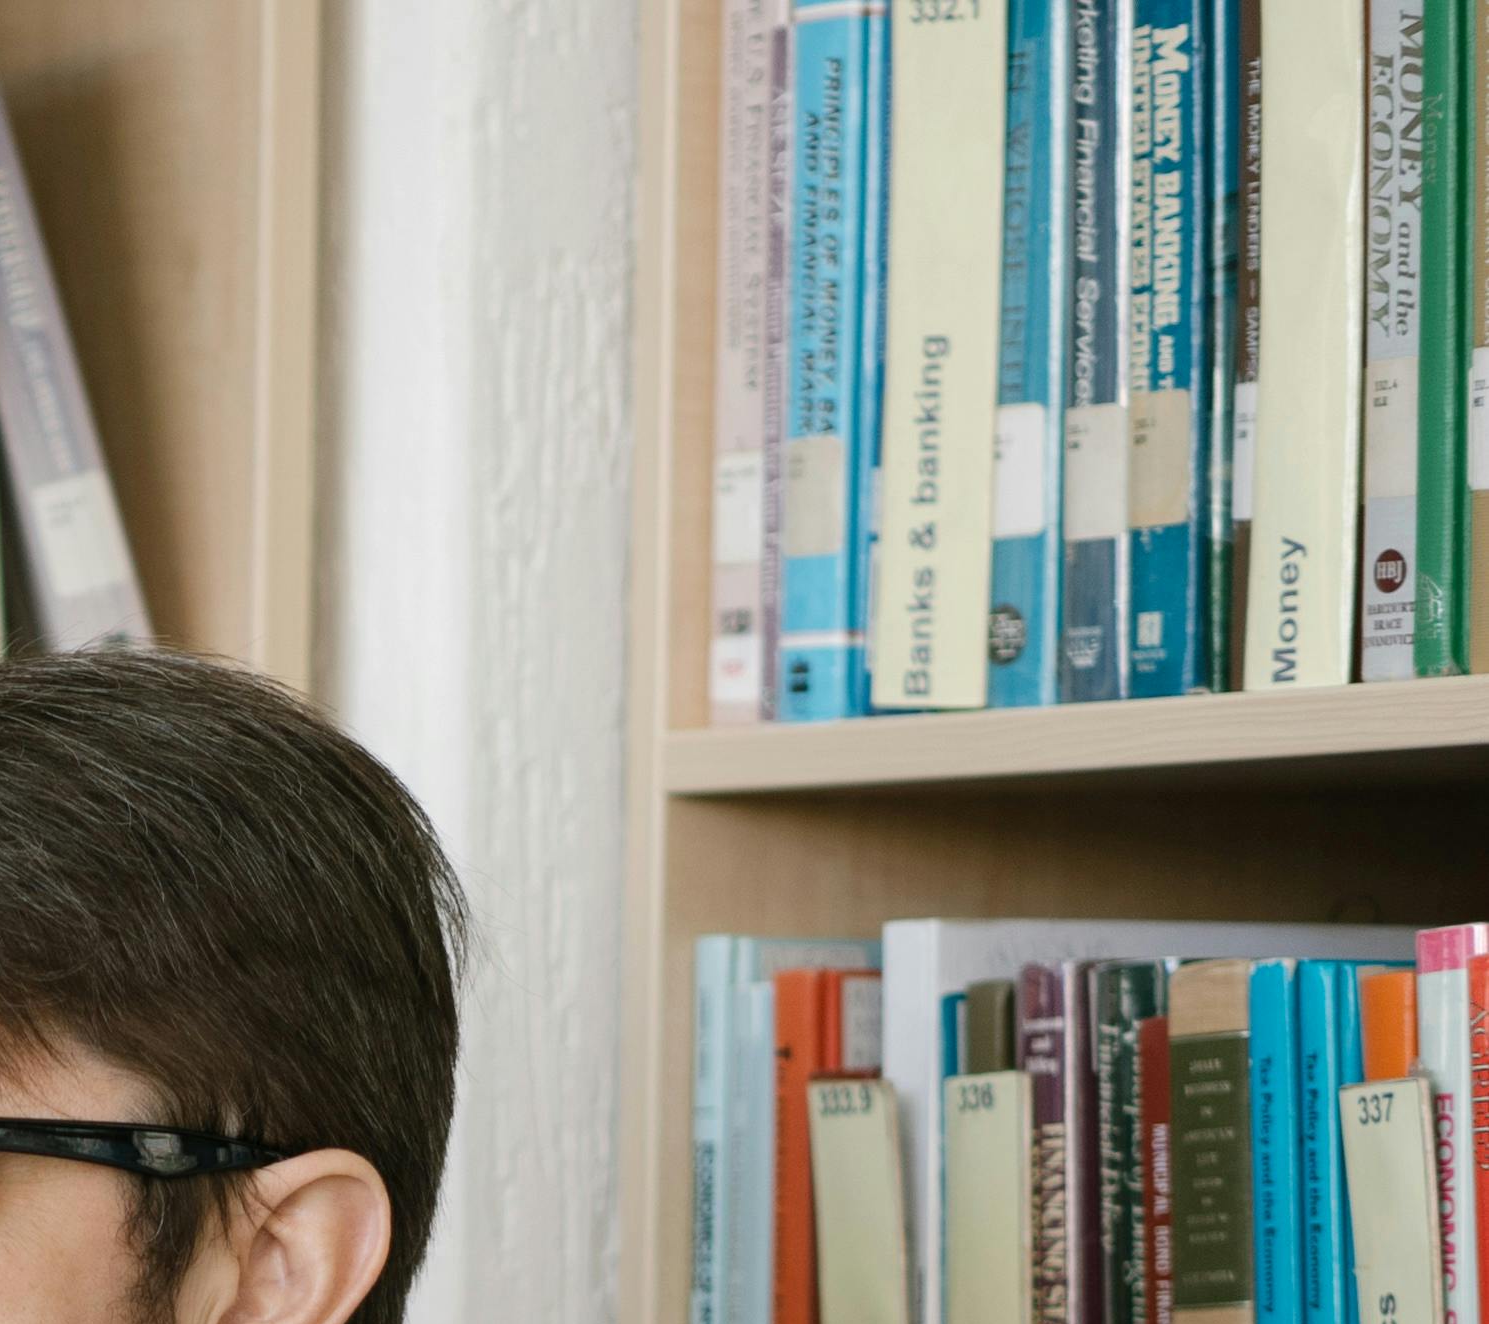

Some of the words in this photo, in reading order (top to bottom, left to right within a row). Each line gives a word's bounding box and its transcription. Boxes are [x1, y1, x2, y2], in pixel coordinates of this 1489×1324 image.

[1151, 23, 1190, 165] MONEY,
[1246, 59, 1261, 96] THE
[822, 56, 843, 223] PRINCIPLES
[1246, 104, 1261, 174] MONEY
[1397, 10, 1424, 212] MONEY
[804, 112, 821, 172] AND
[1075, 116, 1100, 262] Financial
[1369, 53, 1395, 338] ECONOMY
[822, 234, 841, 267] OF
[1152, 169, 1182, 332] BANKING,
[1245, 180, 1261, 272] LENDERS
[1395, 221, 1412, 281] and
[801, 184, 820, 333] FINANCIAL
[1393, 288, 1416, 337] the
[911, 335, 950, 506] banking
[908, 521, 939, 550] &
[1374, 557, 1407, 583] HBJ
[904, 566, 936, 697] Banks
[1273, 536, 1308, 683] Money
[1260, 1057, 1276, 1088] Tax
[1306, 1052, 1320, 1083] Tax
[1260, 1092, 1276, 1148] Policy
[1306, 1087, 1320, 1143] Policy
[1356, 1093, 1395, 1126] 337
[1151, 1123, 1171, 1215] MUNICIPAL
[1261, 1151, 1277, 1186] and
[1307, 1146, 1321, 1181] and
[1309, 1186, 1322, 1217] the
[1309, 1221, 1323, 1312] Economy
